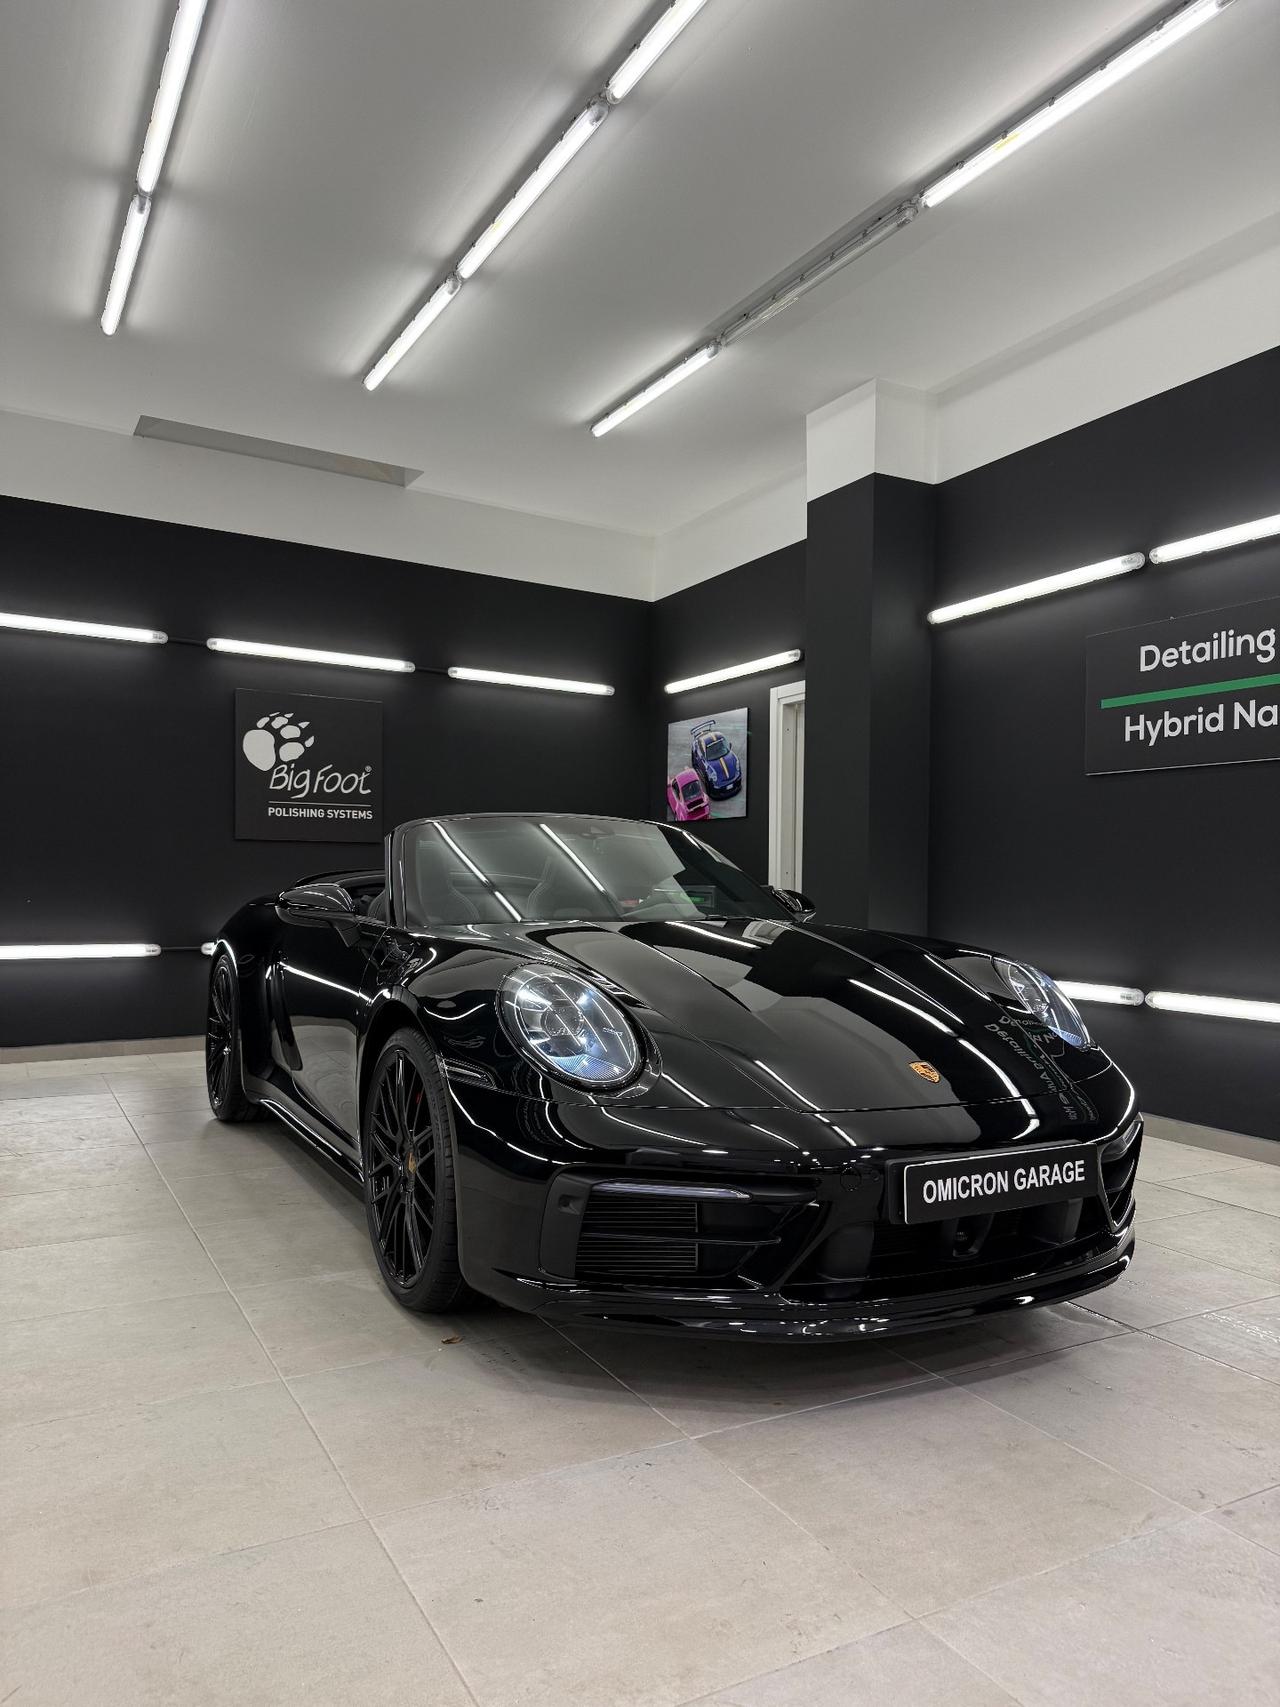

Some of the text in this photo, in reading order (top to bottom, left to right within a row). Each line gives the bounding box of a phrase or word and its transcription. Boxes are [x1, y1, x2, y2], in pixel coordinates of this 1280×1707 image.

[1139, 628, 1276, 672] Detailing
[1124, 699, 1279, 747] Hybrid Na
[268, 806, 373, 820] POLISHING SYSTEMS
[922, 1159, 1086, 1204] OMICRON GARAGE
